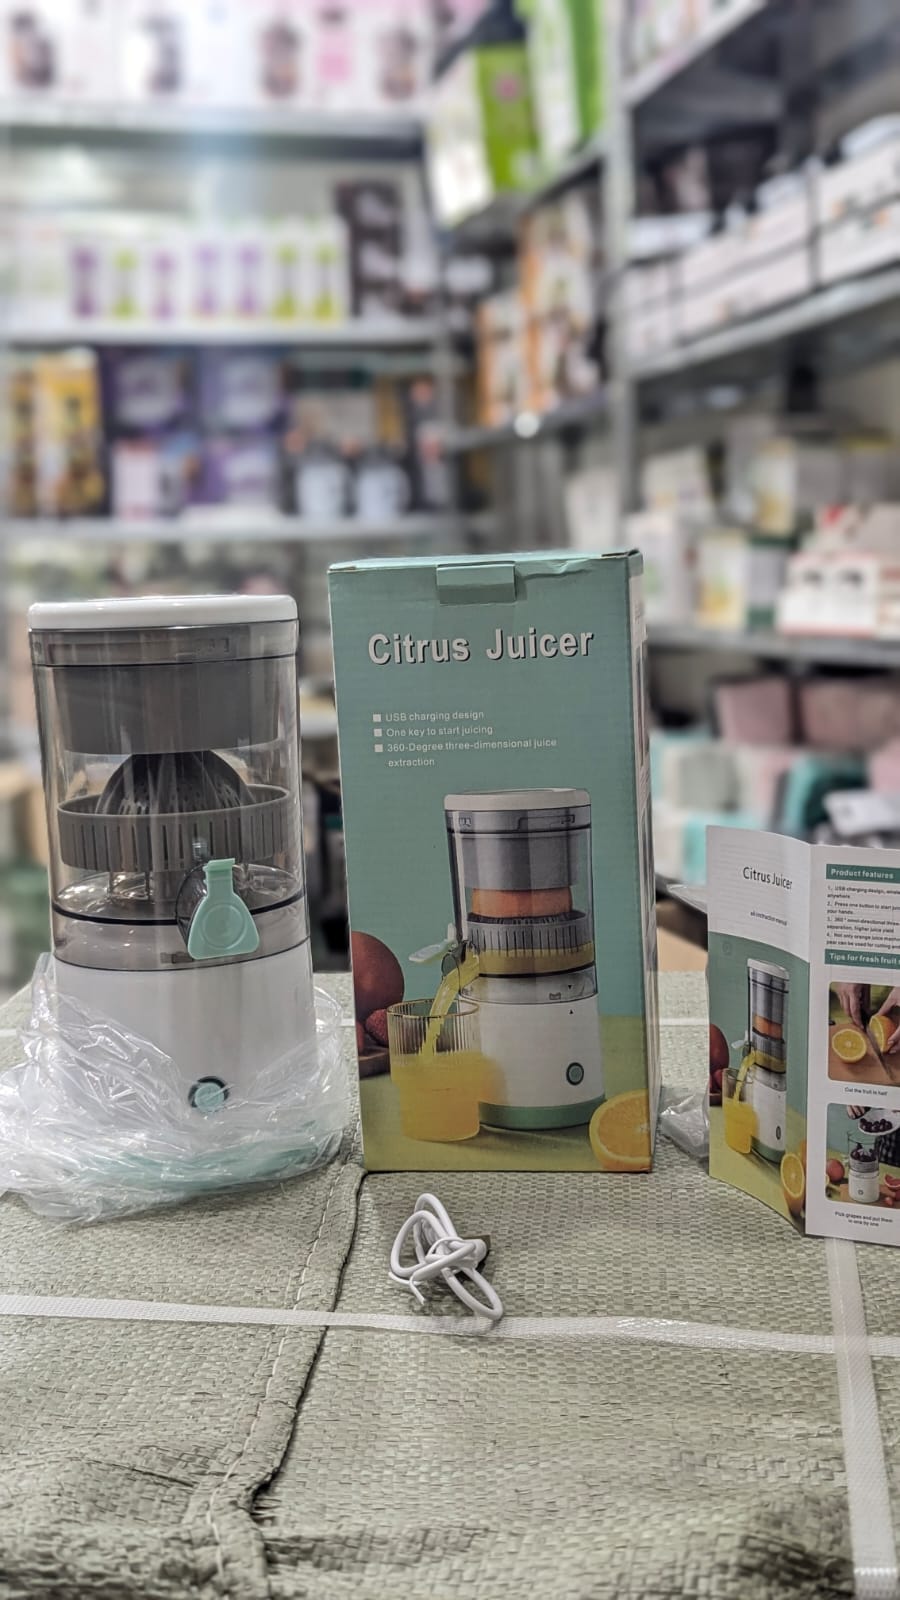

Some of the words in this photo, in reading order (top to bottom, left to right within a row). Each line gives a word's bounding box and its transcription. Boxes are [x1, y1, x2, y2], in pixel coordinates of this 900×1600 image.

[368, 633, 471, 665] Citrus
[486, 627, 594, 660] Juicer
[385, 713, 407, 722] USB
[409, 711, 450, 722] charging
[452, 710, 485, 721] design
[386, 728, 406, 737] One
[408, 727, 425, 738] key
[427, 727, 436, 736] to
[438, 726, 460, 735] start
[461, 725, 493, 736] juicing
[387, 743, 443, 753] 360-Degree
[445, 740, 532, 751] three-dimensional
[533, 738, 557, 749] juice
[388, 757, 435, 767] extraction
[743, 866, 770, 884] Citrus
[772, 872, 793, 890] Juicer
[830, 868, 861, 878] Product
[862, 870, 894, 879] features
[829, 953, 846, 962] Tips
[859, 955, 879, 963] fresh
[880, 956, 896, 964] fruit
